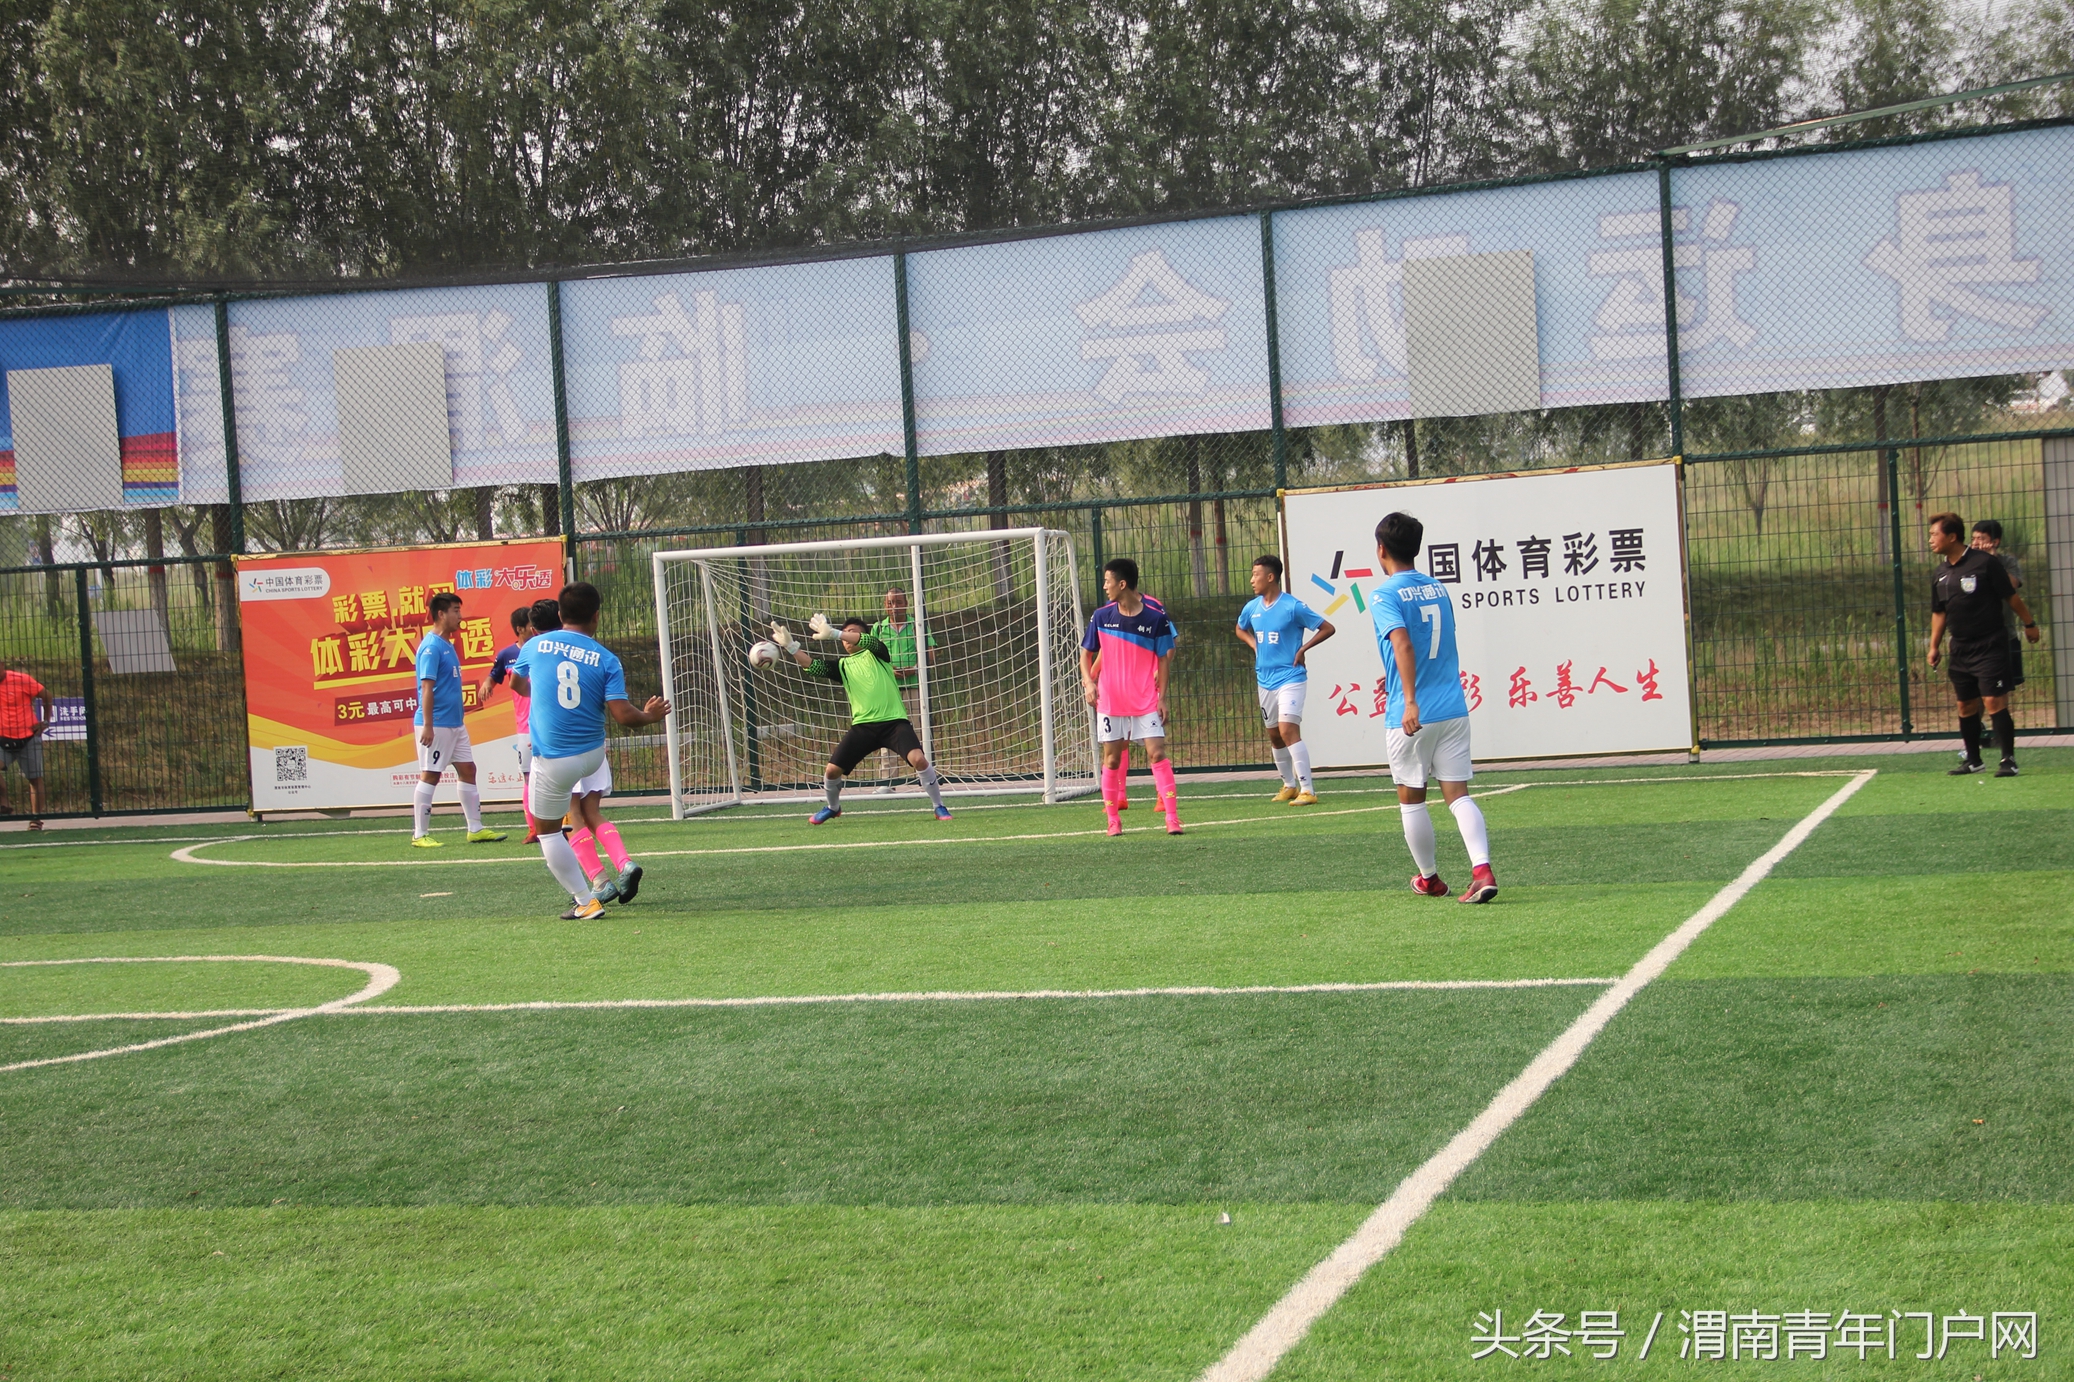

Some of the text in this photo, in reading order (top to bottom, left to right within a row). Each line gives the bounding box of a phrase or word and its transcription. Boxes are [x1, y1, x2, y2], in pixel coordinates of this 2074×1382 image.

[265, 574, 323, 587] 中国体育彩票
[455, 564, 552, 591] 体彩大乐透
[1461, 581, 1646, 610] SPORTS LOTTERY
[1419, 603, 1441, 660] 7
[310, 617, 494, 677] 体彩大透
[537, 639, 601, 668] 中兴通讯
[557, 660, 581, 710] 8
[1508, 658, 1663, 710] 乐善人生
[1103, 716, 1112, 733] 3
[432, 750, 440, 765] 9
